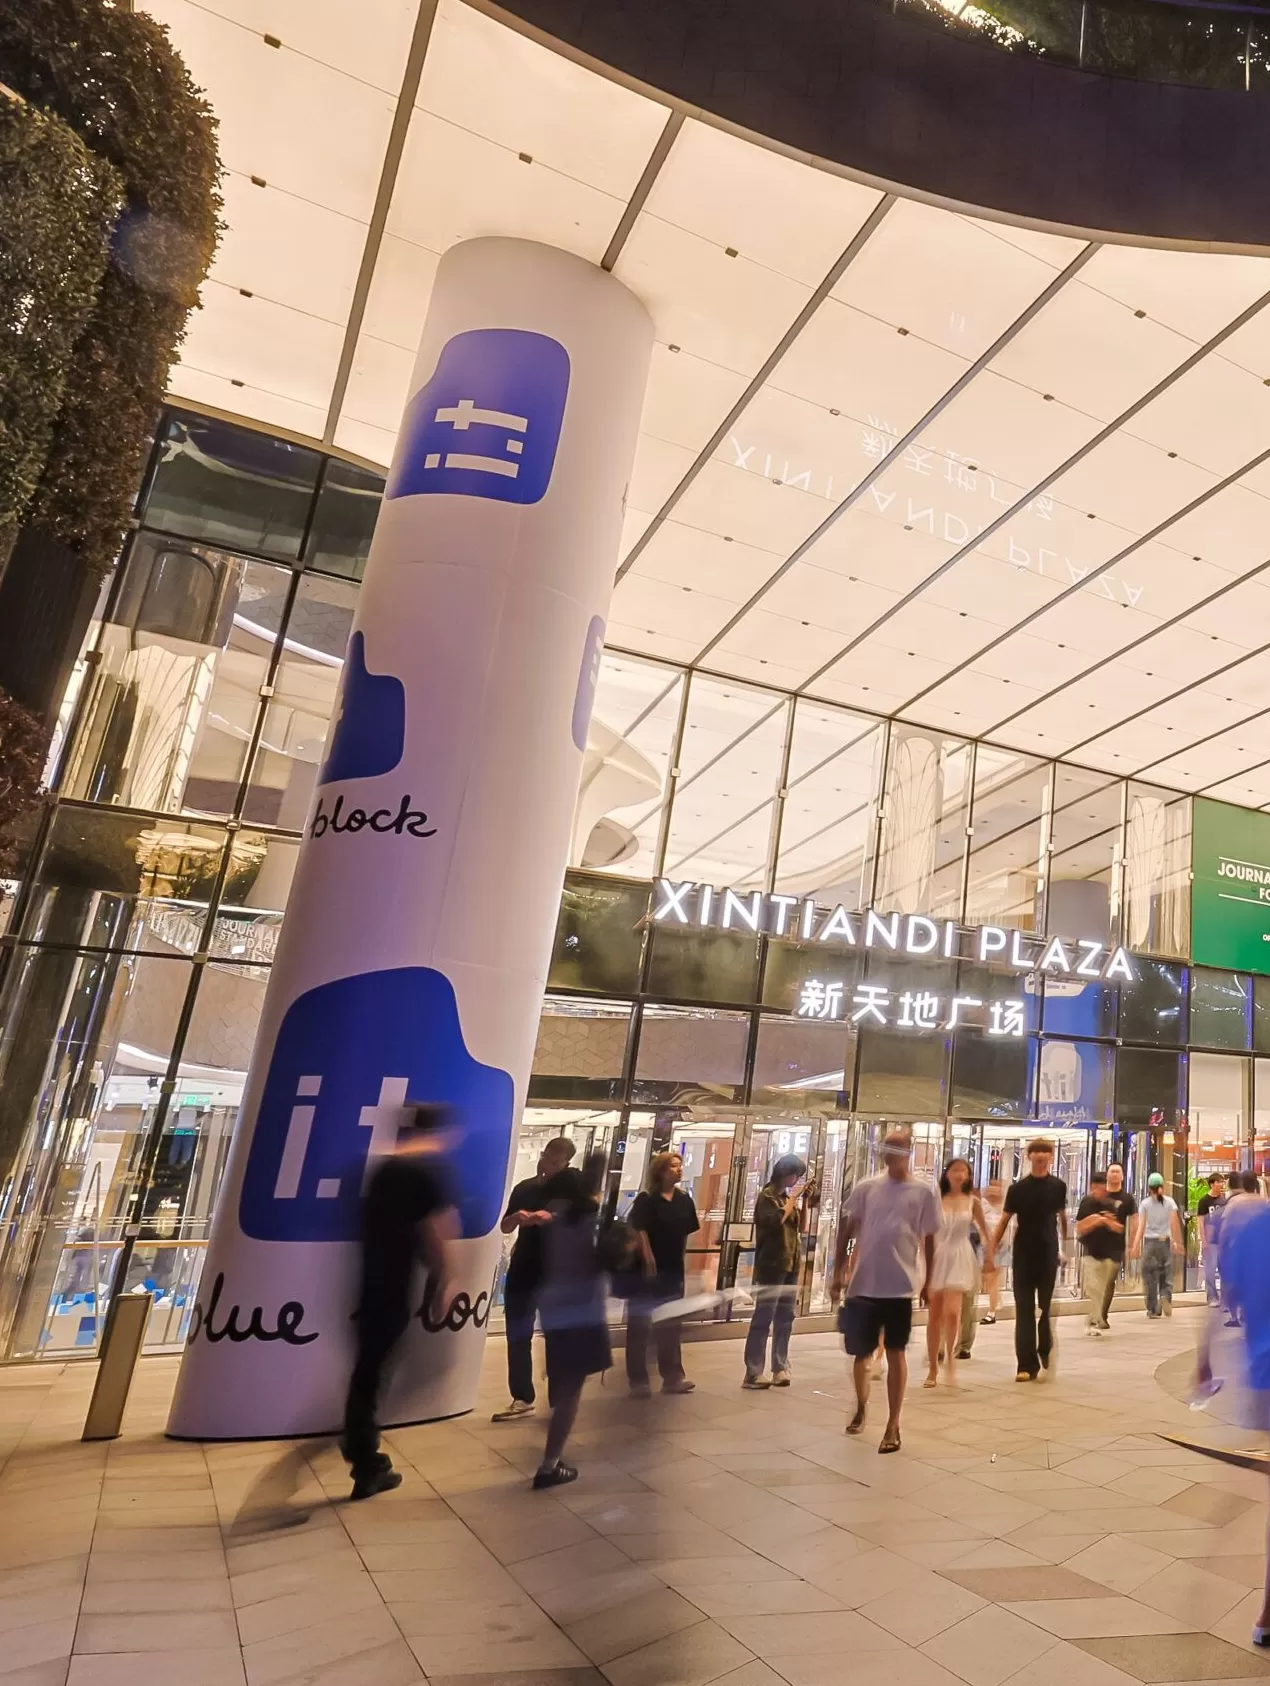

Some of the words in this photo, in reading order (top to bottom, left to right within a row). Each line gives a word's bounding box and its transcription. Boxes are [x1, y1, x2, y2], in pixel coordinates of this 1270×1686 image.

[309, 794, 438, 840] block
[653, 877, 954, 958] XINTIANDI
[978, 925, 1134, 982] PLAZA
[799, 978, 1025, 1037] 新天地广场
